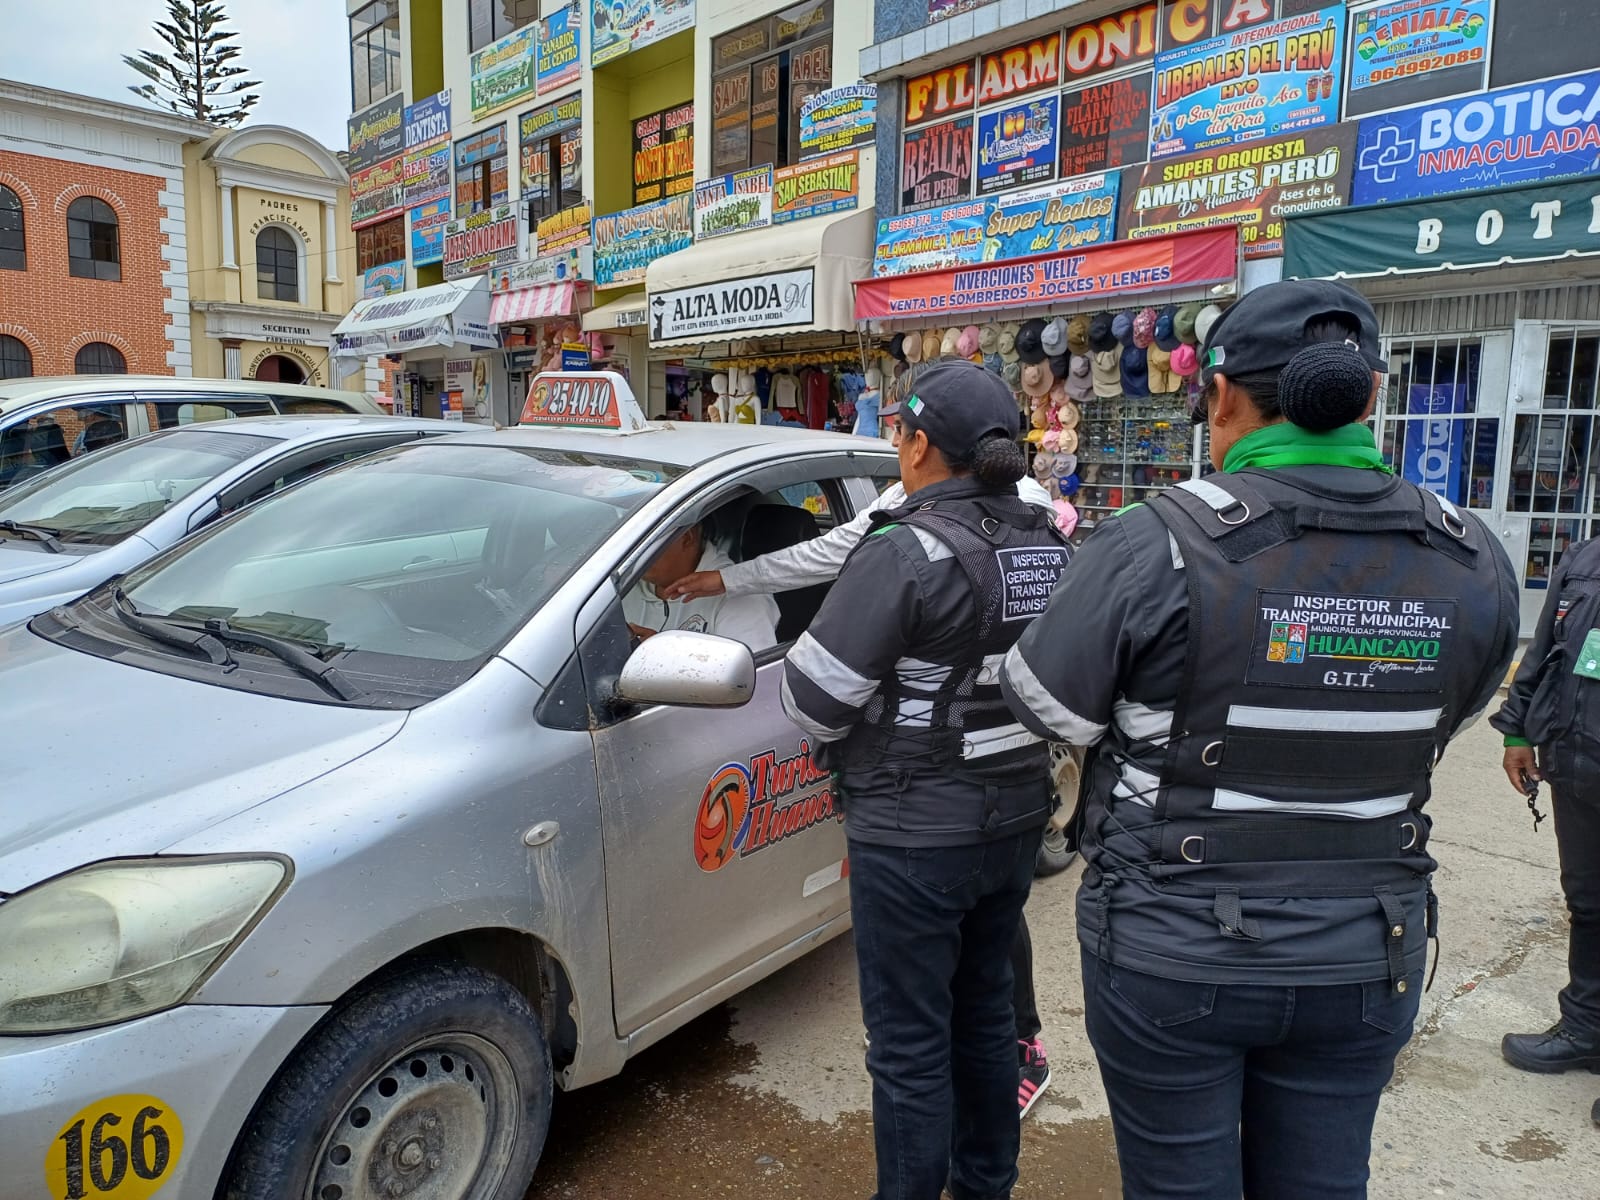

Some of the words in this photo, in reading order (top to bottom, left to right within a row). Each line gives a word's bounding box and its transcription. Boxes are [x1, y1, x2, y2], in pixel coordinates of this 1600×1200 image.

[542, 30, 575, 56] CANARIOS
[1158, 50, 1188, 62] ORQUESTA
[1230, 13, 1321, 47] INTERNACIONAL
[1357, 7, 1485, 61] GENIALES
[1388, 42, 1408, 54] HYO
[539, 60, 552, 73] DEL
[552, 45, 578, 69] CENTRO
[1156, 49, 1245, 110] LIBERALES
[1247, 38, 1281, 75] DEL
[1284, 19, 1336, 72] PERÚ
[1369, 47, 1483, 83] 964992089
[800, 93, 828, 117] UNION
[830, 84, 878, 105] JUVENTUD
[1081, 80, 1132, 105] BANDA
[1188, 106, 1213, 125] Sus
[1212, 95, 1266, 123] juveniles
[1269, 86, 1302, 107] Ases
[1220, 79, 1259, 101] HYO
[522, 111, 554, 138] SONORA
[557, 99, 582, 119] SHOW
[636, 113, 661, 138] GRAN
[665, 105, 695, 130] BANDA
[1066, 90, 1147, 127] FILARMONICA
[1206, 118, 1228, 136] del
[1230, 109, 1265, 132] Perú
[405, 110, 449, 148] DENTISTA
[641, 132, 660, 150] SON
[925, 121, 954, 138] SUPER
[903, 126, 974, 193] REALES
[1163, 158, 1214, 181] SUPER
[1217, 139, 1305, 170] ORQUESTA
[1417, 123, 1600, 177] INMACULADA
[404, 157, 429, 180] REAL
[1134, 168, 1258, 212] AMANTES
[1262, 147, 1340, 187] PERÚ
[260, 198, 299, 213] PADRES
[696, 184, 727, 210] SANTA
[733, 173, 771, 194] ISABEL
[914, 182, 932, 203] DEL
[1178, 201, 1199, 218] De
[1202, 186, 1264, 211] Huancayo
[1280, 190, 1304, 202] Ases
[1307, 185, 1321, 197] de
[1323, 183, 1335, 194] la
[594, 217, 616, 252] SON
[616, 195, 692, 240] CONTINENTAL
[972, 203, 985, 216] 95
[986, 209, 1043, 238] Super
[1043, 196, 1114, 226] Reales
[249, 213, 312, 245] FRANCISCANOS
[444, 234, 465, 266] JAZZ
[465, 217, 517, 260] SONORAMA
[1030, 228, 1055, 251] del
[1055, 221, 1101, 251] Perú
[1176, 220, 1205, 232] Ramos
[876, 231, 946, 260] FILARMÓNICA
[950, 227, 983, 248] VILCA
[889, 297, 926, 312] VENTA
[929, 295, 949, 307] DE
[949, 286, 1028, 305] SOMBREROS
[1038, 277, 1094, 296] JOCKES
[1097, 275, 1108, 289] Y
[1111, 265, 1171, 286] LENTES
[953, 264, 1035, 292] INVERCIONES
[1037, 256, 1086, 280] "VELIZ"
[672, 292, 718, 322] ALTA
[721, 283, 782, 314] MODA
[262, 323, 311, 336] SECRETARIA
[671, 323, 686, 332] VISTE
[720, 317, 737, 325] VISTE
[764, 312, 783, 320] MODA
[248, 347, 272, 377] CONVENTO
[1011, 552, 1064, 568] INSPECTOR
[1006, 568, 1057, 585] GERENCIA
[1261, 607, 1357, 627] TRANSPORTE
[1360, 614, 1451, 630] MUNICIPAL
[1293, 595, 1390, 614] INSPECTOR
[1402, 601, 1425, 615] DE
[1308, 634, 1441, 659] HUANCAYO
[1310, 625, 1375, 635] MUNICIPALIDAD
[1378, 628, 1426, 638] PROVINCIAL
[1430, 631, 1442, 639] DE
[1323, 670, 1375, 688] G.T.T.
[59, 1105, 170, 1200] 166
